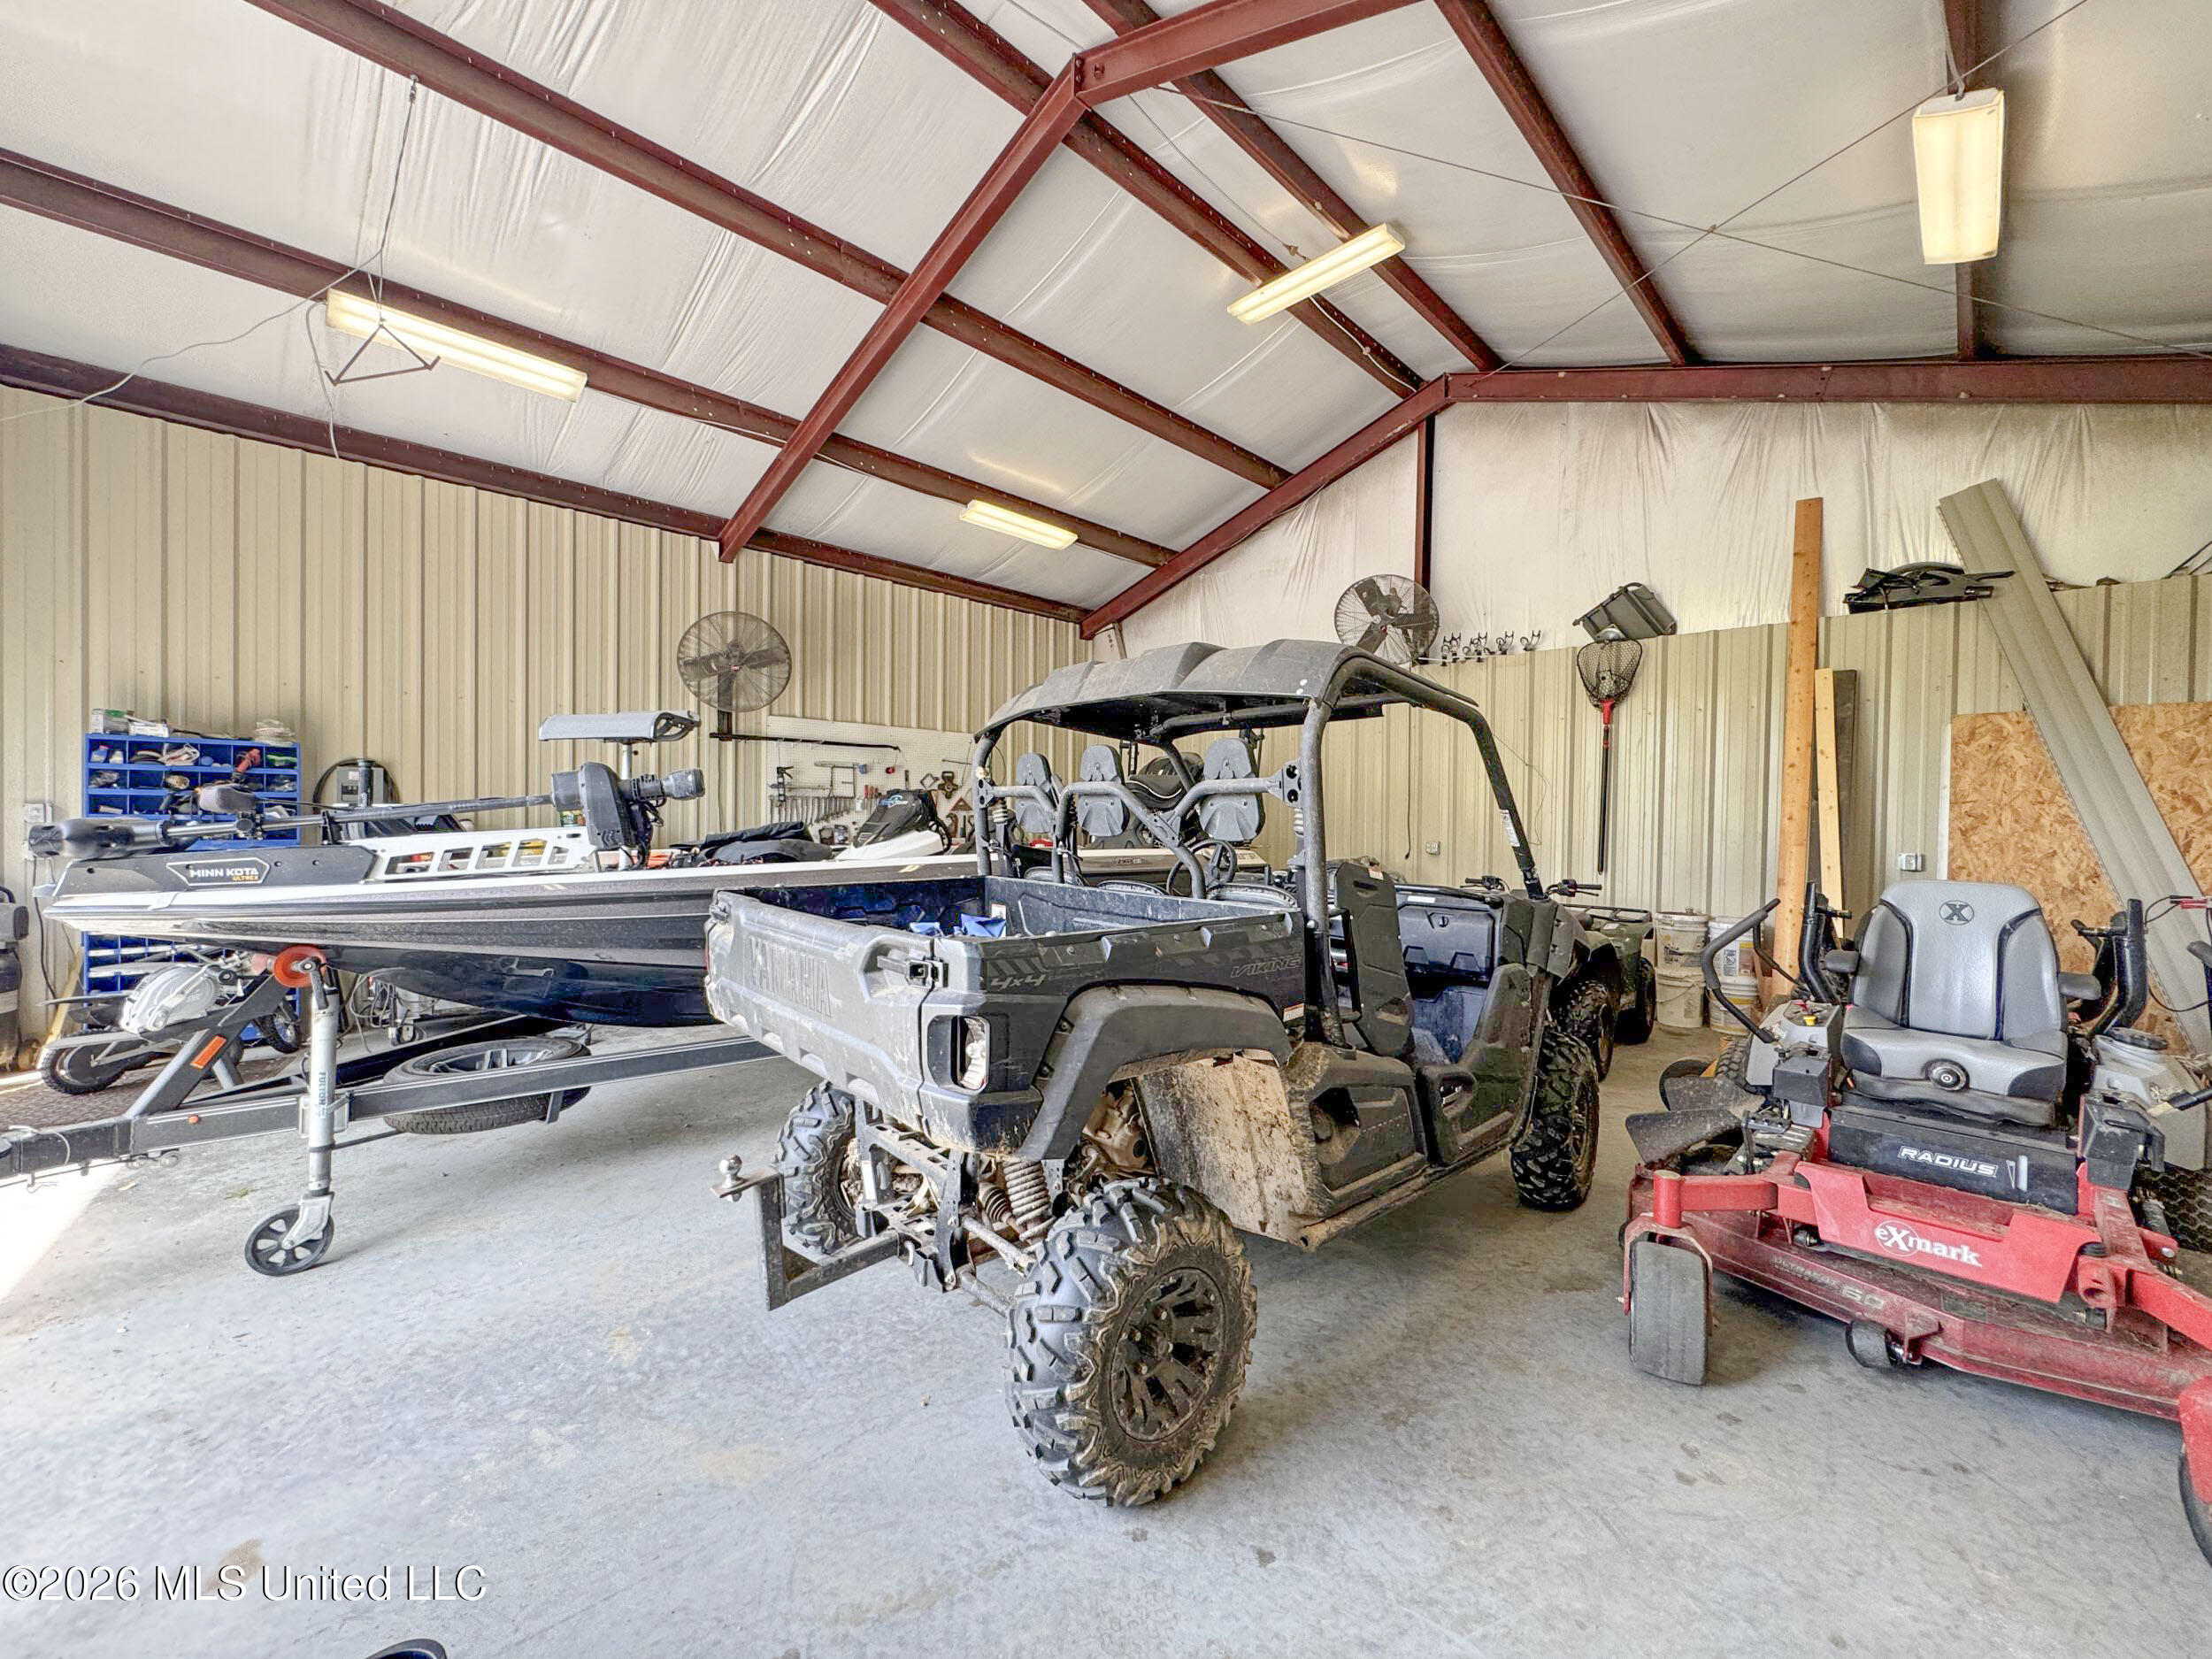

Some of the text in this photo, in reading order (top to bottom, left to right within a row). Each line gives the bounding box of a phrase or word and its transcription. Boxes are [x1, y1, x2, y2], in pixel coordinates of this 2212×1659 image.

[190, 867, 259, 878] MINN KOTA
[749, 935, 832, 1018] YAMAHA
[990, 974, 1046, 990] 4x4
[1898, 1146, 1998, 1178] RADIUS
[1841, 1285, 1885, 1310] 60
